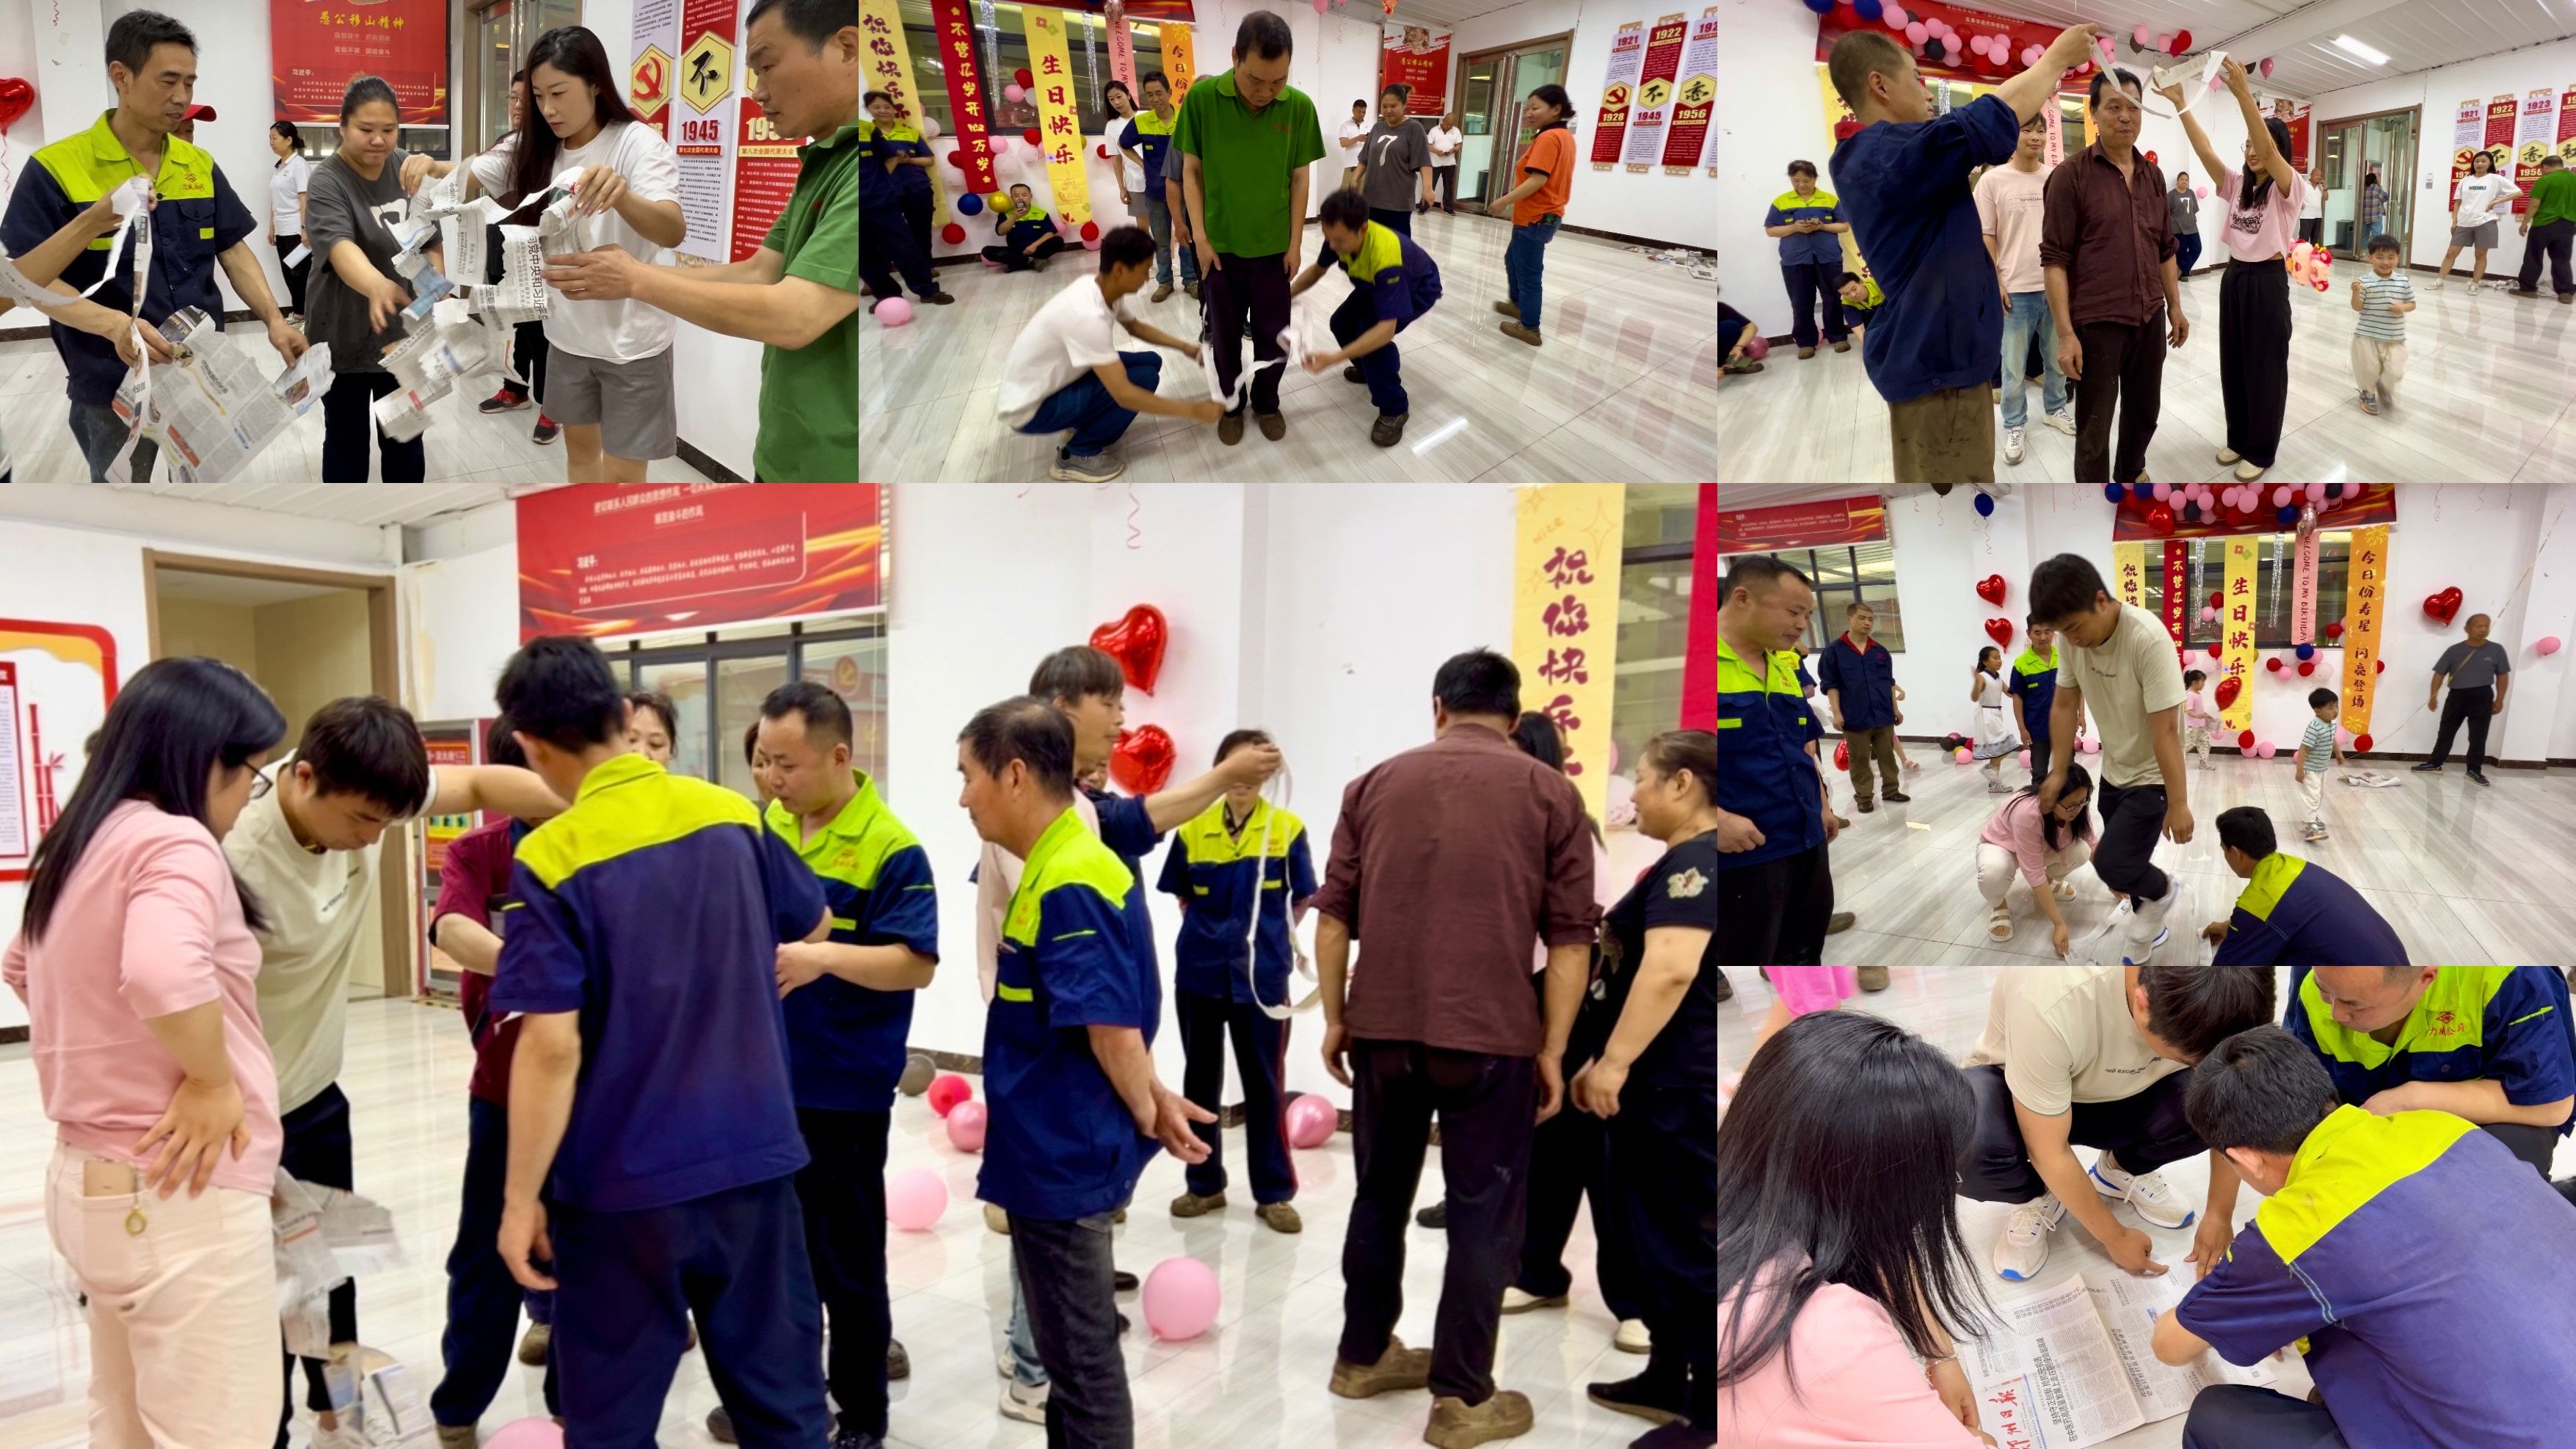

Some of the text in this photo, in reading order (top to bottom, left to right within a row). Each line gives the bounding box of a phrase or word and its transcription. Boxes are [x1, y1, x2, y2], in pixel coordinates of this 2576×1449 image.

[319, 11, 404, 31] 愚公移山精神
[1656, 27, 1682, 40] 1922
[1618, 35, 1638, 46] 1921
[1120, 62, 1127, 71] TO
[950, 22, 989, 171] 不管几岁开心万岁
[1041, 54, 1075, 164] 生日快乐
[2492, 105, 2514, 114] 1922
[2527, 100, 2551, 109] 1923
[1603, 112, 1625, 121] 1928
[1637, 112, 1662, 120] 1945
[1678, 109, 1707, 119] 1956
[2461, 110, 2478, 118] 1921
[682, 120, 720, 141] 1945
[2302, 576, 2310, 586] TO
[2302, 587, 2310, 600] MY
[2172, 560, 2184, 658] 不管几岁开心
[2229, 577, 2249, 676] 生日快乐
[2300, 602, 2309, 642] BIRTHDAY
[2351, 551, 2376, 708] 今日份寿星 闪亮登场
[2429, 1023, 2464, 1036] 力威公司
